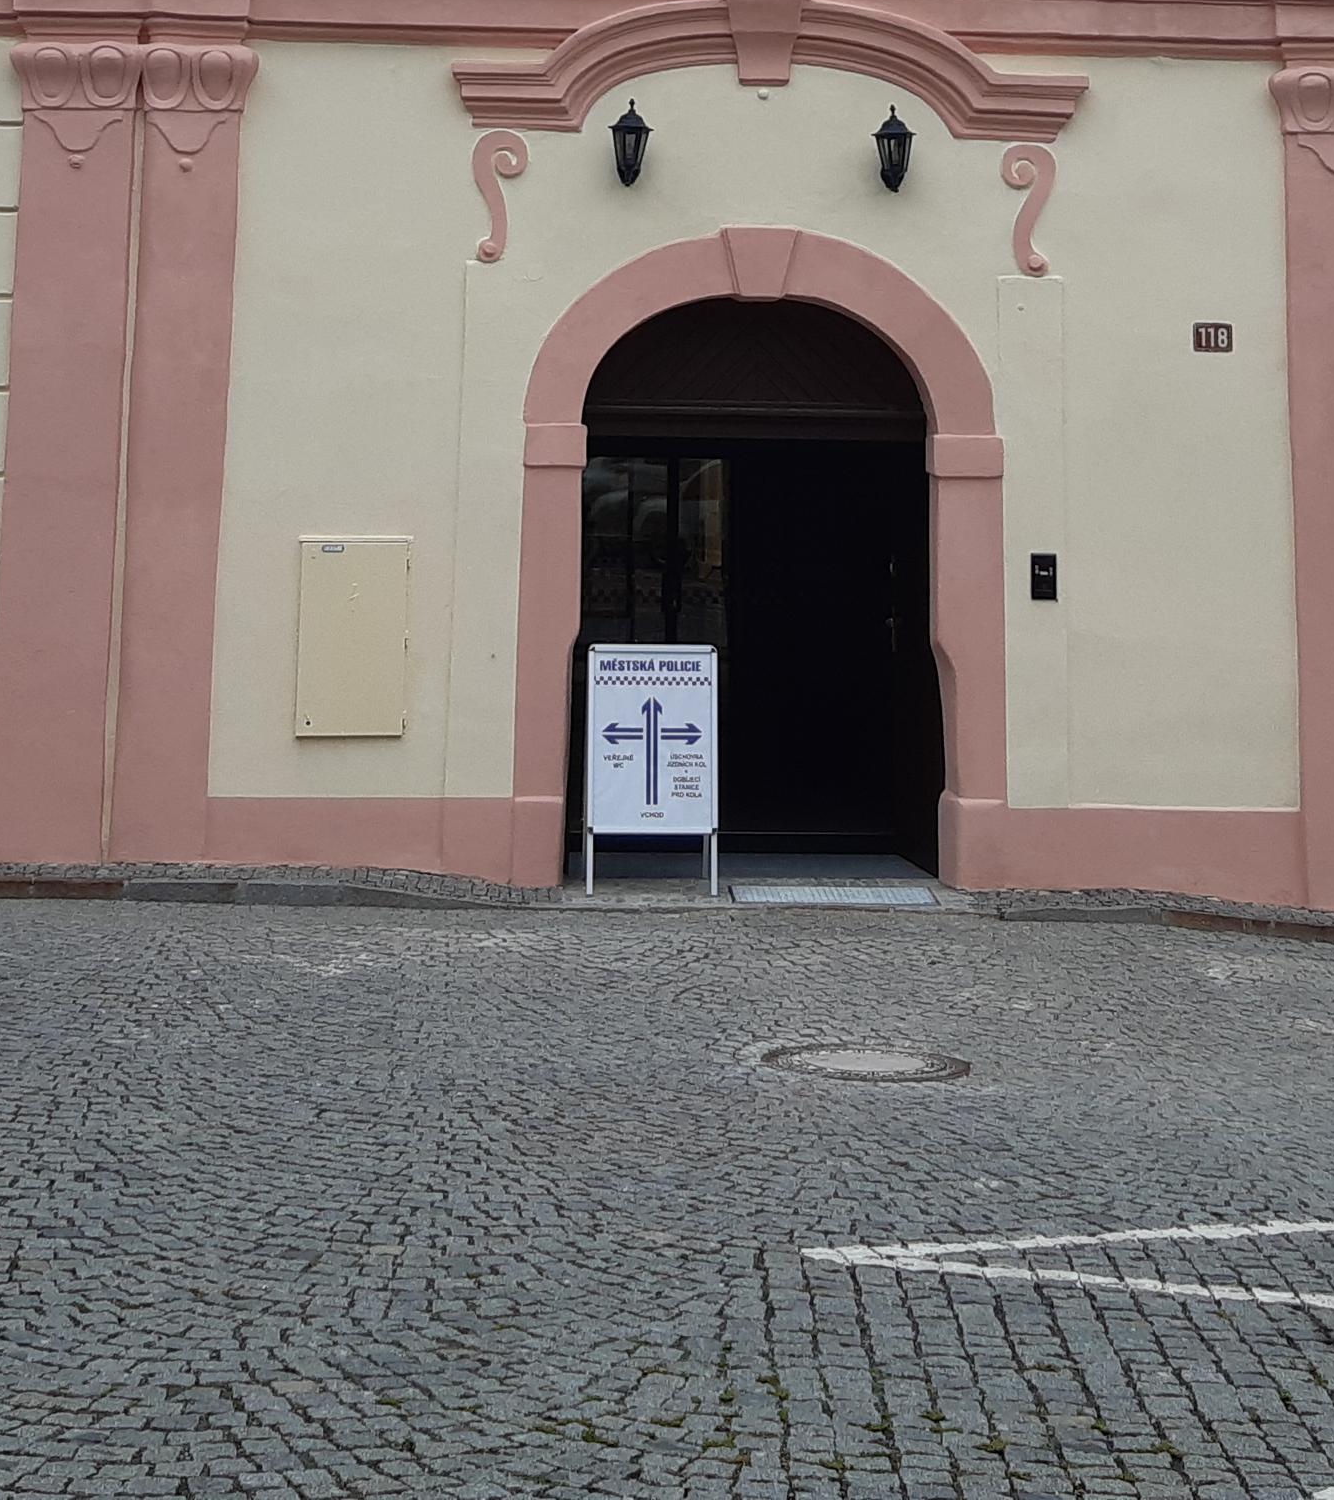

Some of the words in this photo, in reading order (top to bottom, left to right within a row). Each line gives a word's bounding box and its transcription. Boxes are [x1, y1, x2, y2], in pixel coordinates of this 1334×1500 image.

[1198, 327, 1228, 348] 118
[599, 658, 655, 672] MĚSTSKÁ
[658, 660, 702, 672] POLICIE
[640, 811, 665, 819] VCHOD
